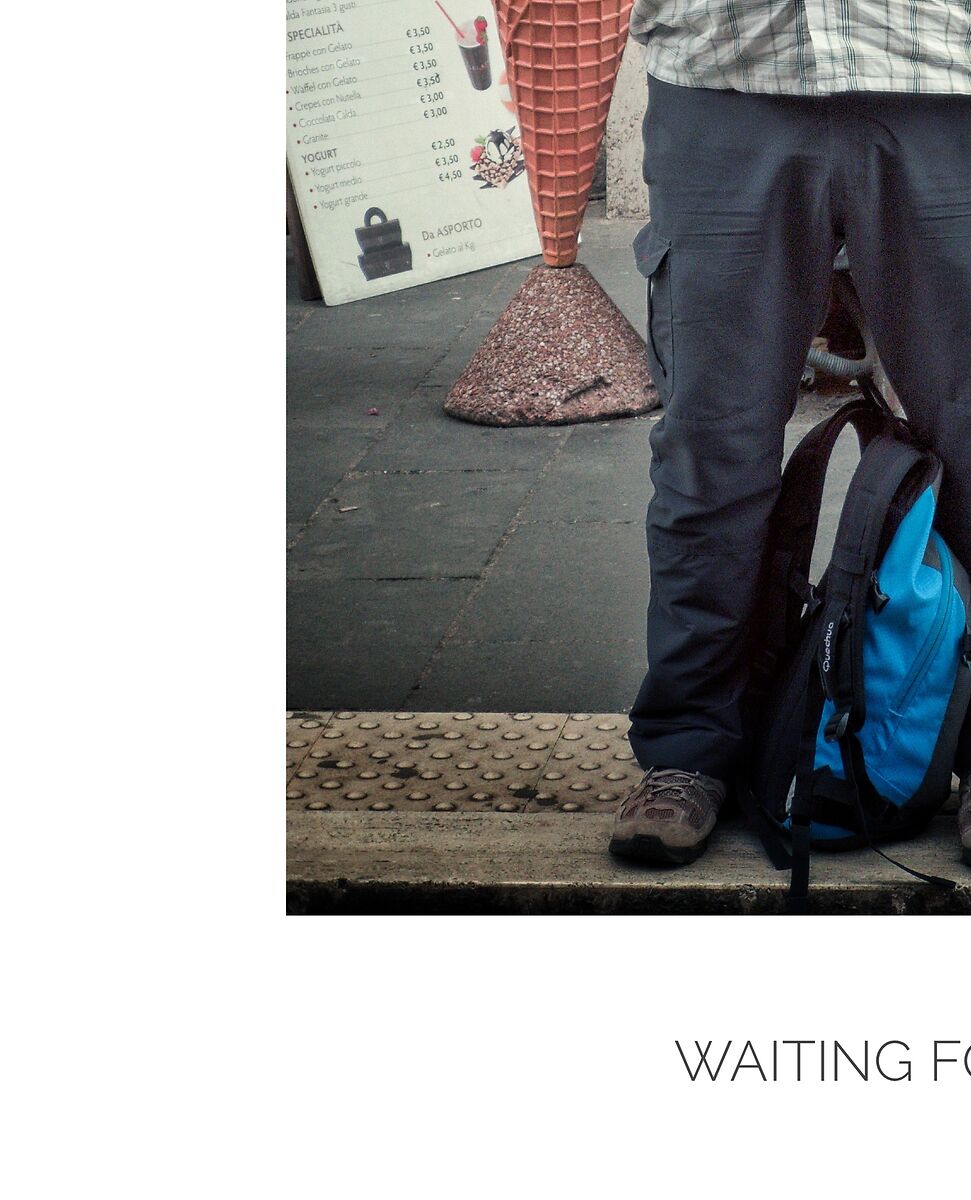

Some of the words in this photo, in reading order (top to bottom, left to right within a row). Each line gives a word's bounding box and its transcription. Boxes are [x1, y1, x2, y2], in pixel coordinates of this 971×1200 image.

[312, 47, 327, 56] con
[328, 42, 353, 53] Gelato
[321, 63, 336, 72] con
[336, 58, 361, 69] Gelato
[317, 81, 331, 90] con
[333, 76, 357, 87] Gelato
[322, 97, 336, 106] con
[301, 148, 337, 163] YOGURT
[311, 164, 335, 177] Yogurt
[314, 181, 338, 195] Yogurt
[319, 197, 343, 211] Yogurt
[421, 230, 435, 241] Da
[437, 218, 482, 237] ASPORTO
[432, 246, 456, 258] Gelato
[822, 622, 834, 672] Quechua
